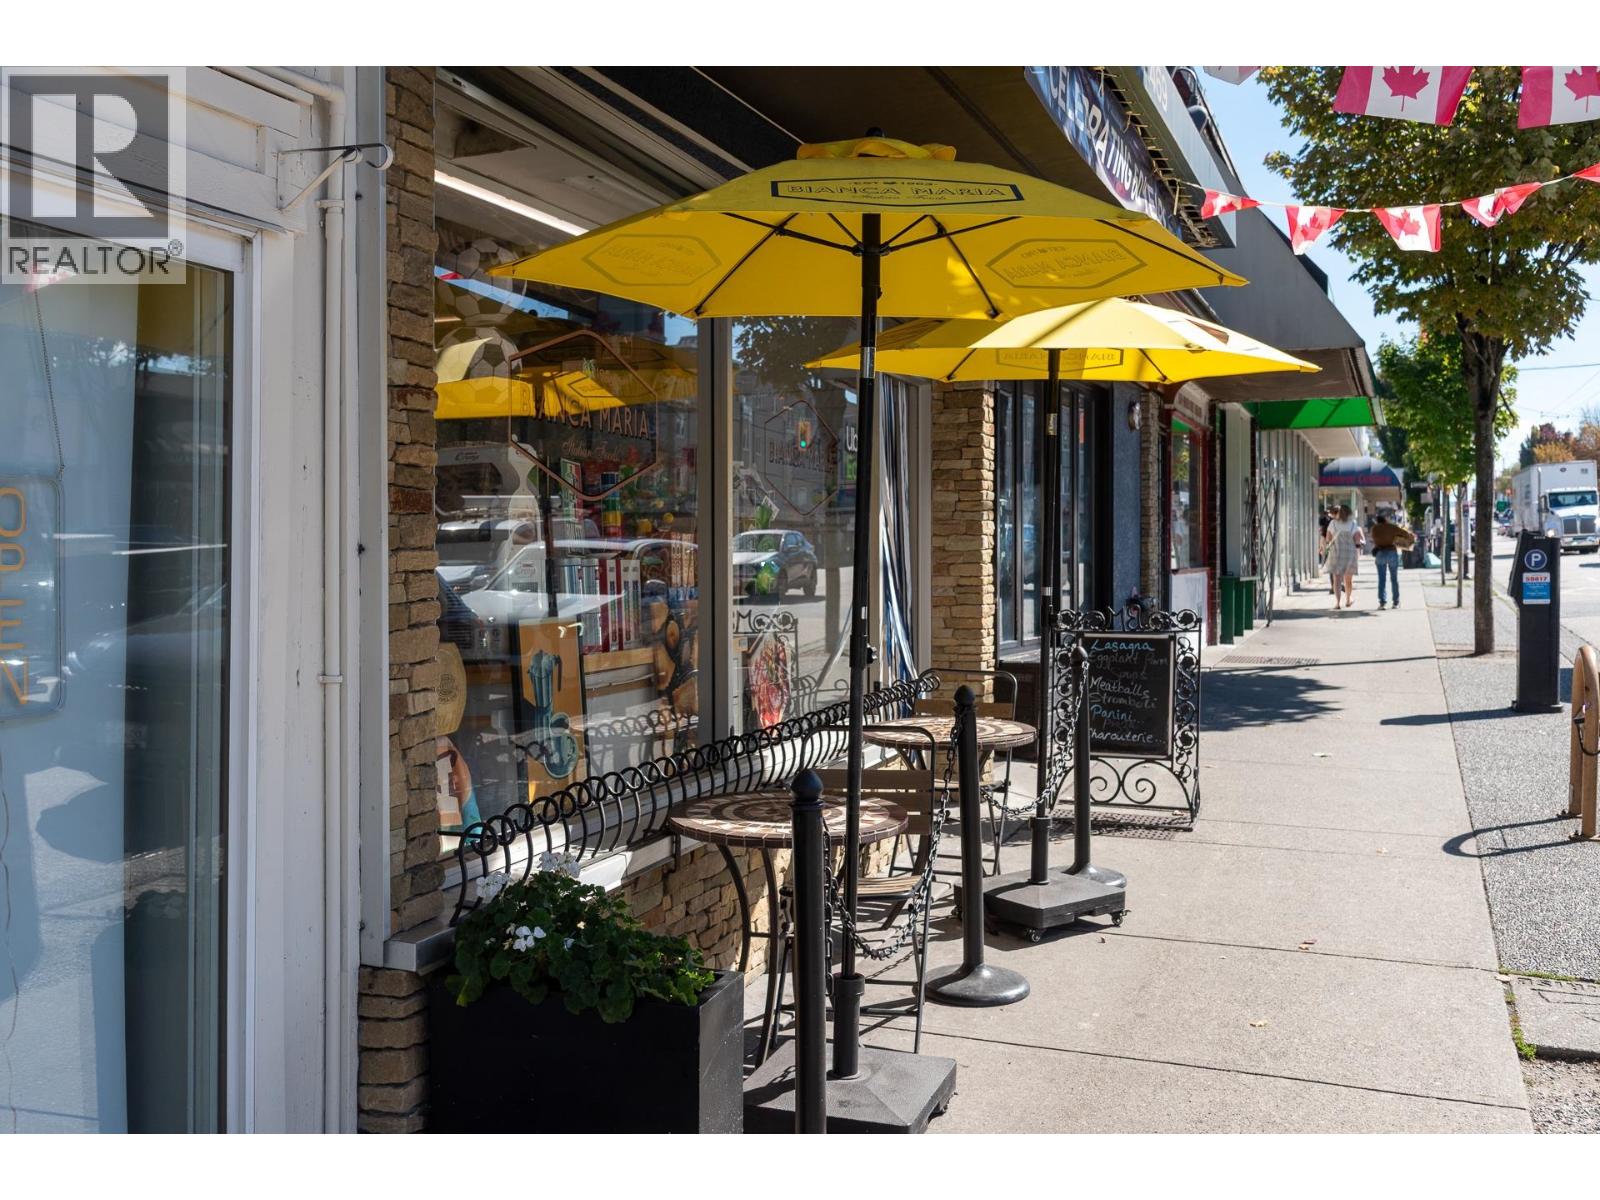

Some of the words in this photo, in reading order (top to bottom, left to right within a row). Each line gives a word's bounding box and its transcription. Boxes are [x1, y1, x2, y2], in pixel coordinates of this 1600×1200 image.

[787, 184, 900, 195] BIANCA
[911, 186, 1005, 196] MARIA
[599, 405, 650, 440] MARIA
[1531, 553, 1542, 567] P
[1090, 639, 1156, 656] Lasagna
[1090, 676, 1151, 699] Meatballs
